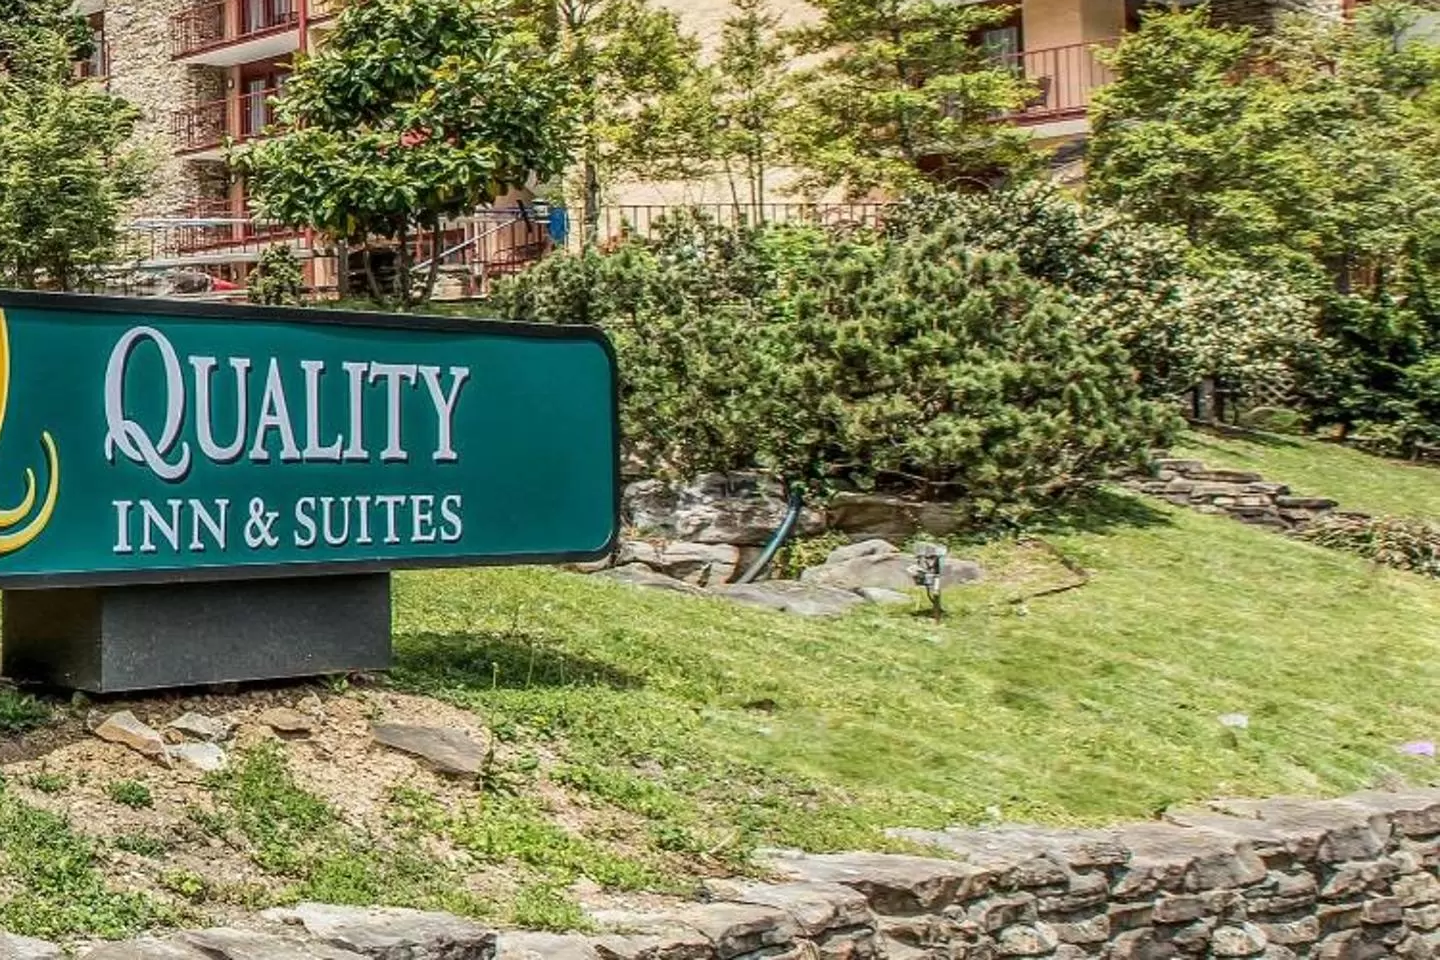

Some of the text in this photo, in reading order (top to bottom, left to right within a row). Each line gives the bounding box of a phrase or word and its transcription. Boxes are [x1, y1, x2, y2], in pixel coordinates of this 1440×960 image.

[104, 326, 470, 480] QUALITY
[112, 494, 462, 552] INN & SUITES
